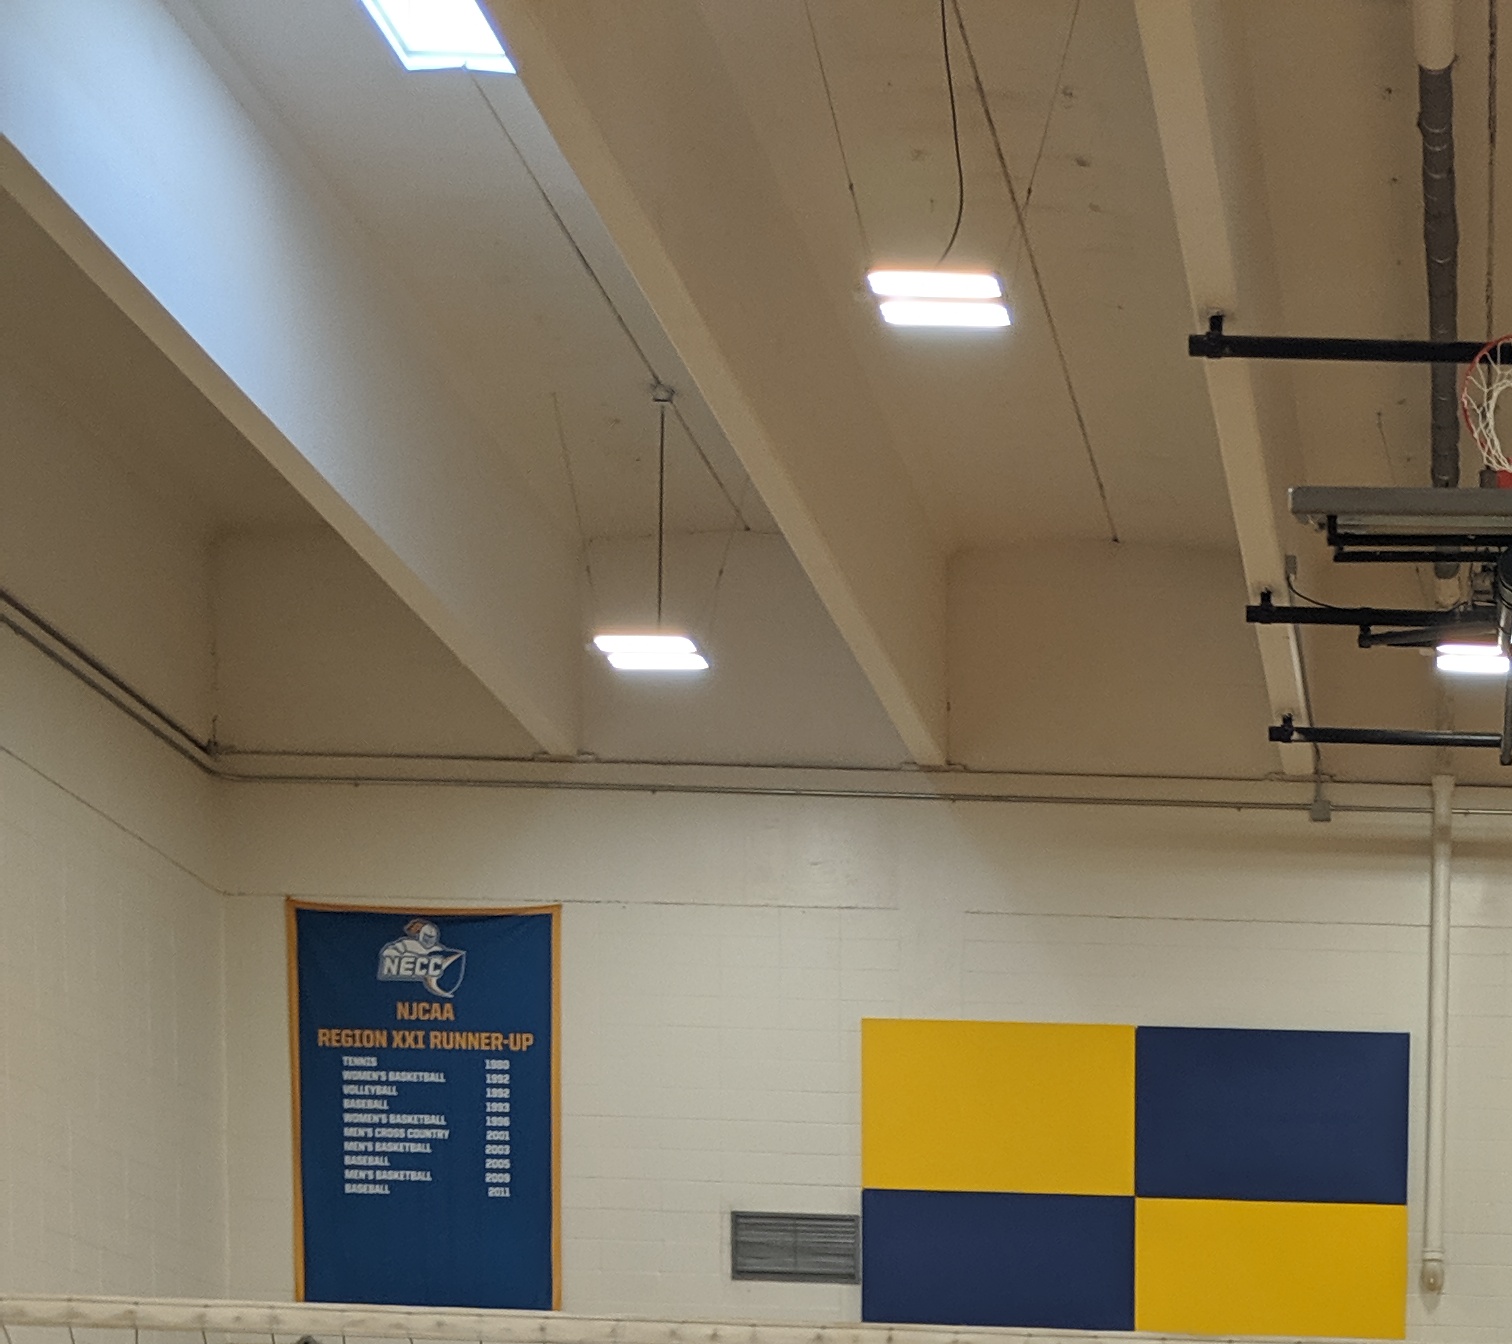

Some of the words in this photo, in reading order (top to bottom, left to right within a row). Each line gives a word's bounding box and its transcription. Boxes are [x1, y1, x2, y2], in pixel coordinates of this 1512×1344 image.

[383, 956, 443, 976] NECC
[396, 1003, 455, 1021] NJCAA
[317, 1028, 388, 1048] REGION
[392, 1030, 425, 1049] XXI
[430, 1031, 534, 1051] RUNNER-UP
[388, 1071, 446, 1082] BASKETBALL
[342, 1084, 398, 1096] VOLLEYBALL
[343, 1098, 389, 1110] BASEBALL
[389, 1113, 447, 1125] BASKETBALL
[375, 1142, 432, 1153] BASKETBALL
[344, 1155, 391, 1166] BASEBALL
[375, 1170, 432, 1181] BASKETBALL
[345, 1183, 391, 1194] BASEBALL
